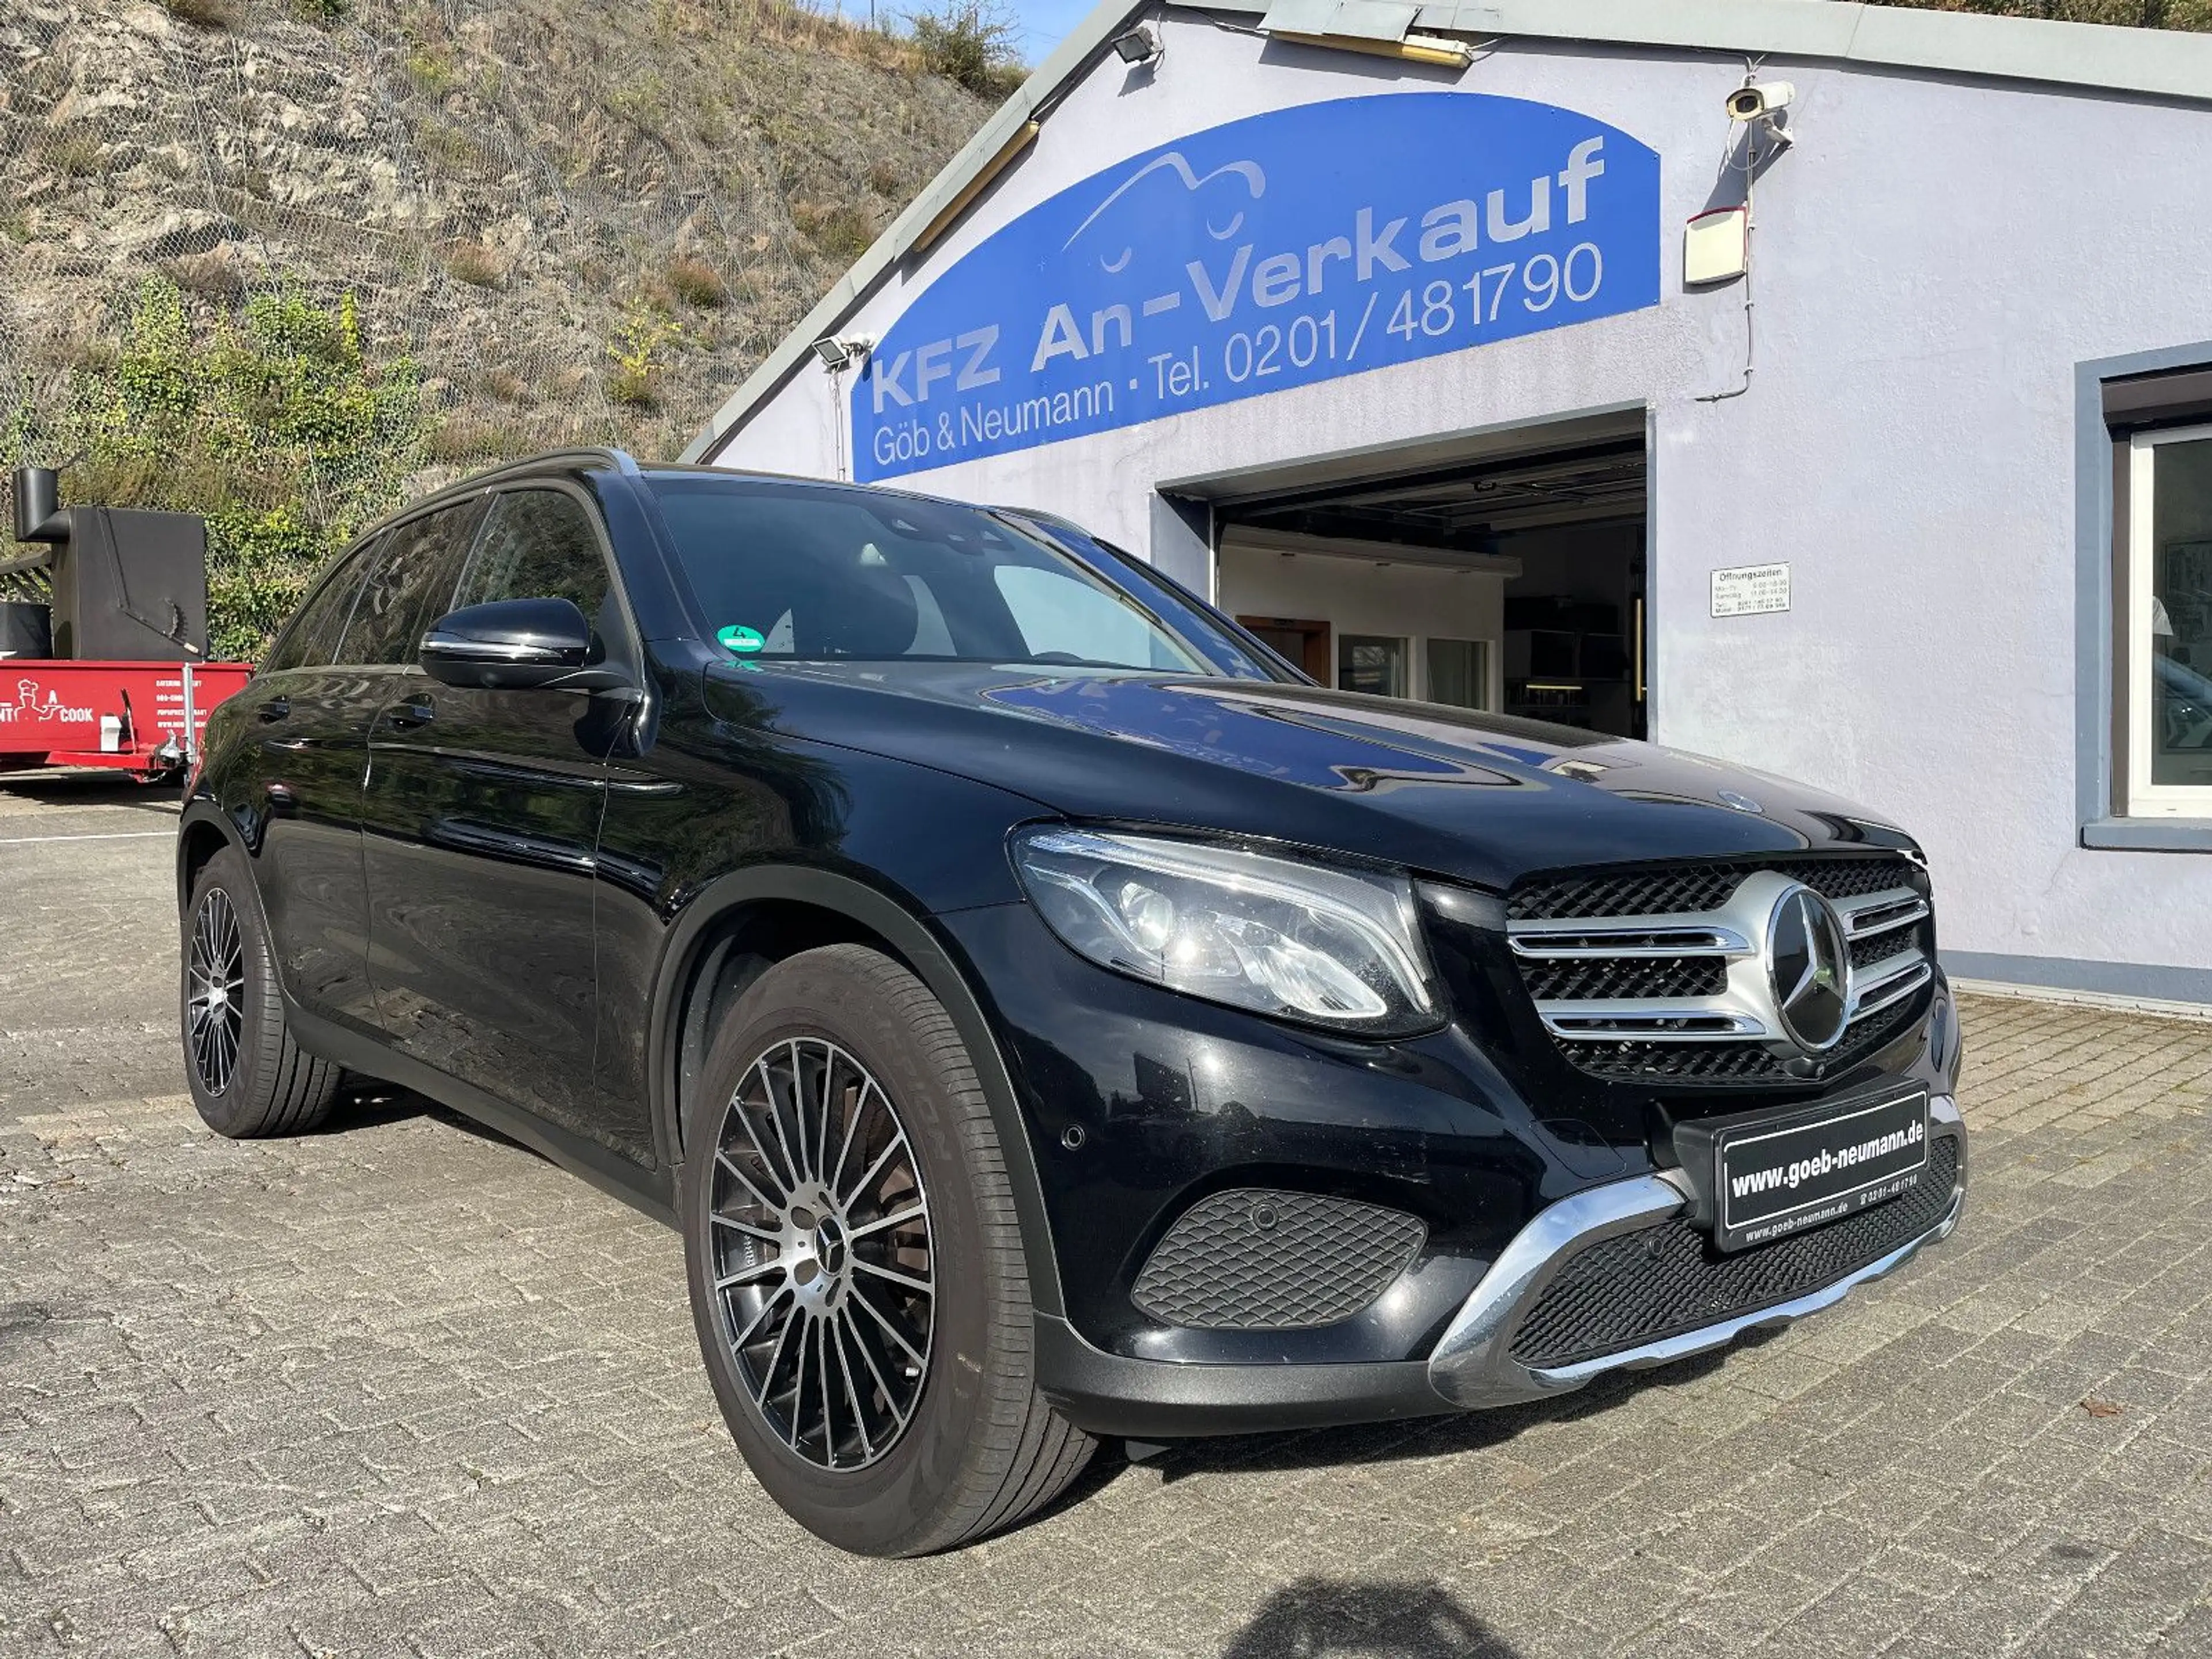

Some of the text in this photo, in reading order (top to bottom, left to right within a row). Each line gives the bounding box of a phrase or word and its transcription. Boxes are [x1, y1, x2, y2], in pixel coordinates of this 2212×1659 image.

[873, 136, 1604, 414] KFZ An-Verkauf
[874, 419, 930, 465] Göb
[937, 412, 956, 450] &
[961, 379, 1114, 446] Neumann
[1147, 346, 1209, 399] Tel.
[732, 626, 747, 638] 4
[48, 690, 58, 704] A
[60, 708, 93, 722] COOK
[1732, 1119, 1923, 1198] www.goeb-neumann.de
[1745, 1201, 1848, 1243] www.goeb-neumann.de
